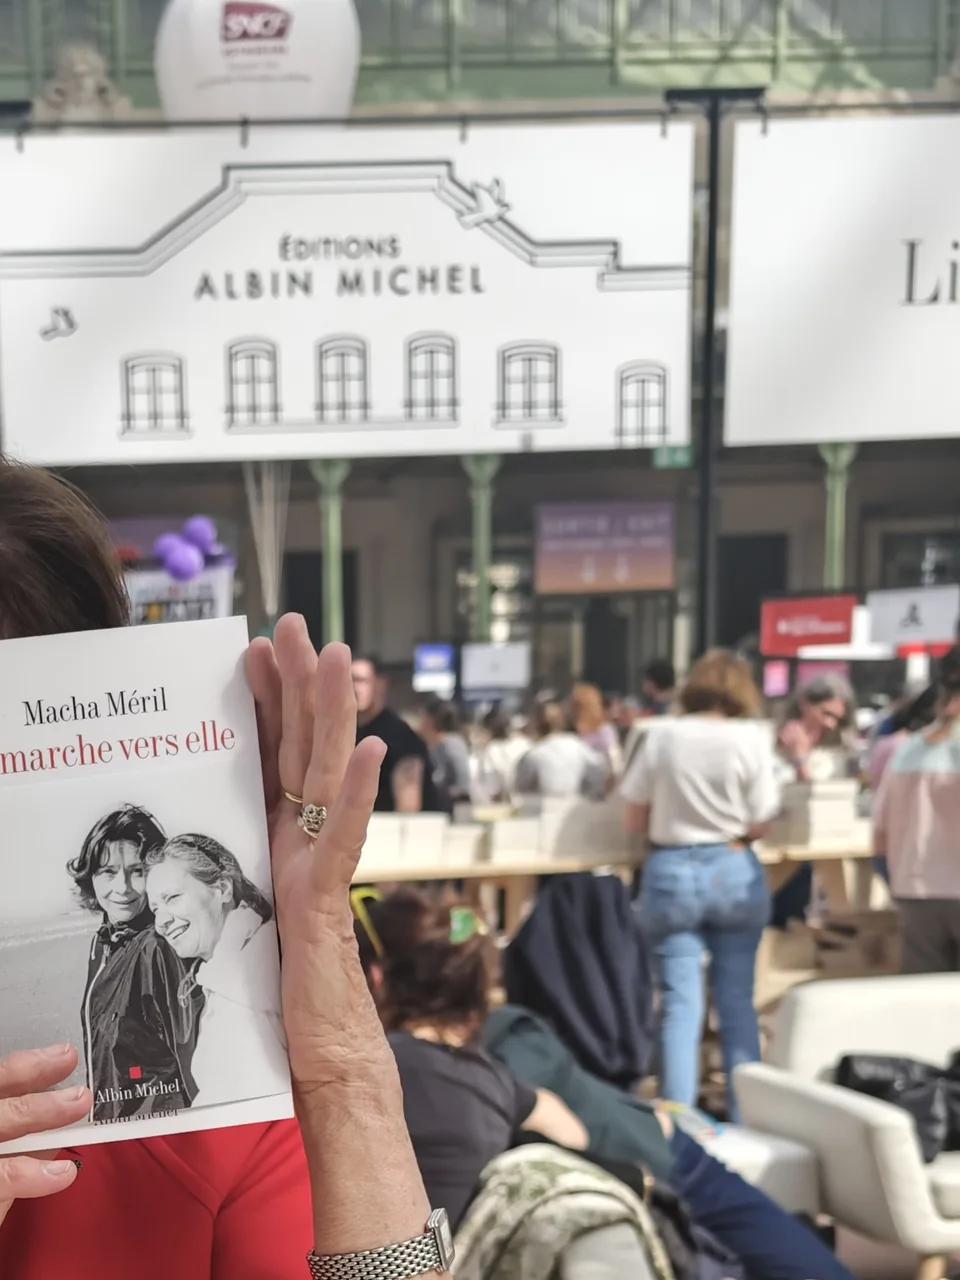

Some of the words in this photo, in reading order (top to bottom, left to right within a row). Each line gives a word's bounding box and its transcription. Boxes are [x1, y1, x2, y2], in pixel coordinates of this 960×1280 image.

[279, 232, 402, 261] ÉDITIONS
[194, 268, 313, 300] ALBIN
[336, 263, 486, 298] MICHEL
[22, 696, 101, 727] Macha
[104, 686, 168, 717] Méril
[0, 734, 113, 776] marche
[117, 732, 179, 761] vers
[185, 719, 236, 753] elle
[95, 1087, 133, 1104] Albin
[135, 1078, 180, 1098] Michel
